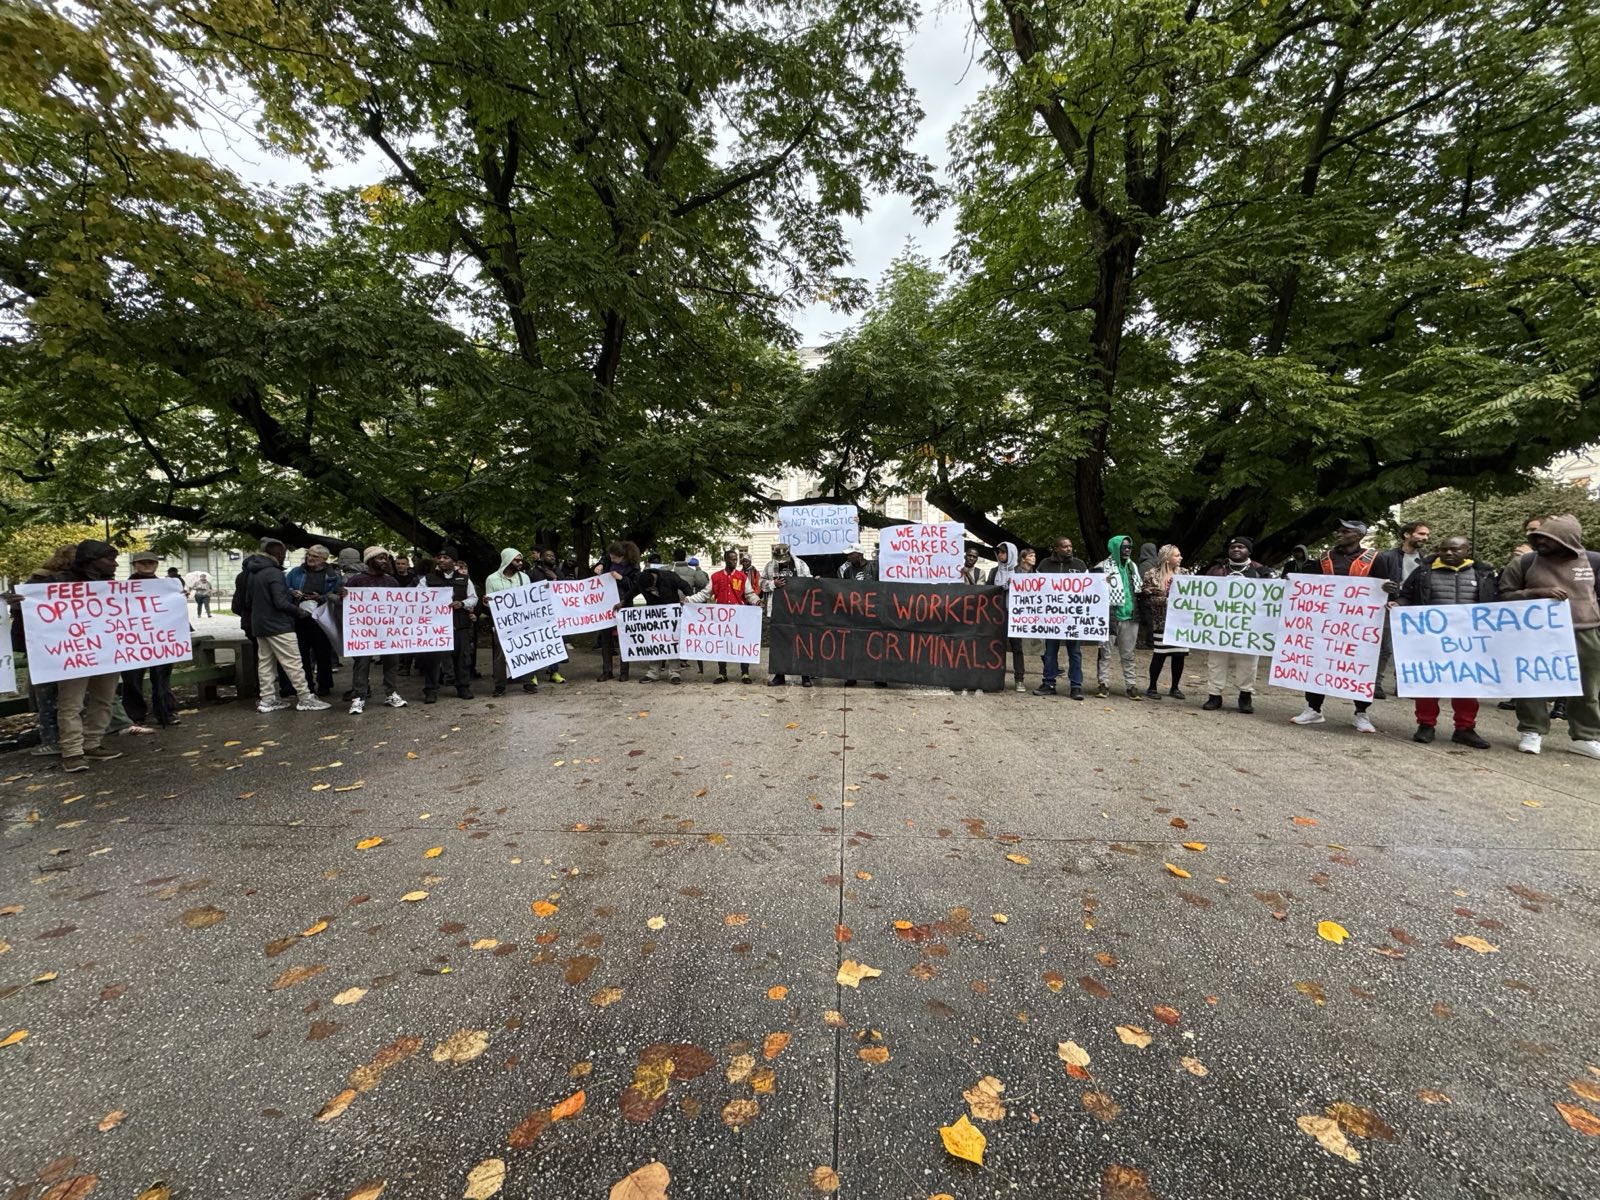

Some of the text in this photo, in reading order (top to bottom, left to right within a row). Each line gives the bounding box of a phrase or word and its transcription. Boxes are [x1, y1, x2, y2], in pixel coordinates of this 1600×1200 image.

[792, 506, 848, 517] RACISM
[811, 517, 854, 526] PATRIOTIC
[782, 529, 853, 547] ITS IDIOTIC
[895, 526, 947, 538] WE ARE
[890, 540, 960, 556] WORKERS
[909, 554, 933, 566] NOT
[886, 564, 963, 580] CRIMINALS
[47, 581, 143, 600] FEEL THE
[552, 578, 604, 594] VEDNO ZA
[1012, 577, 1093, 593] WOOP WOOP
[1176, 580, 1284, 601] WHO DO YO
[1291, 580, 1371, 599] SOME OF
[350, 590, 438, 603] IN A RACIST
[493, 584, 549, 611] POLICE
[561, 592, 605, 607] VSE KRIV
[783, 589, 877, 618] WE ARE
[1012, 593, 1101, 605] THAT'S THE SOUND
[37, 596, 168, 623] OPPOSITE
[349, 604, 453, 615] SOCIETY IT IS NOT
[496, 603, 555, 630] EVERYWHERE
[621, 609, 642, 622] THEY
[644, 608, 667, 620] HAVE
[697, 606, 737, 623] STOP
[892, 592, 1006, 625] WORKERS
[1012, 607, 1025, 615] OF
[1026, 606, 1043, 614] THE
[1173, 598, 1282, 617] CALL WHEN TH
[1289, 597, 1380, 619] THOSE THAT
[68, 616, 155, 637] OF SAFE
[349, 616, 433, 626] ENOUGH TO BE
[624, 619, 678, 633] AUTHORITY
[1012, 615, 1106, 626] WOOP WOOP THAT'S
[1193, 612, 1252, 632] POLICE
[1400, 603, 1565, 635] NO RACE
[351, 625, 449, 638] NON RACIST WE
[630, 633, 679, 644] TO KILL
[687, 622, 745, 639] RACIAL
[1010, 625, 1028, 633] THE
[1030, 625, 1060, 634] SOUND
[1083, 627, 1108, 636] BEAST
[1284, 616, 1381, 644] WOR FORCES
[44, 629, 176, 655] WHEN POLICE
[347, 637, 452, 651] MUST BE ANTI-RACIST
[505, 625, 561, 654] JUSTICE
[685, 639, 759, 657] PROFILING
[793, 629, 851, 660] NOT
[1175, 628, 1276, 652] MURDERS
[1284, 634, 1358, 657] ARE THE
[1441, 635, 1492, 653] BUT
[510, 642, 565, 669] NOWHERE
[627, 643, 679, 657] A MINORIT
[63, 653, 99, 671] ARE
[1280, 650, 1371, 676] SAME THAT
[1401, 654, 1580, 684] HUMAN RACE
[1274, 665, 1376, 698] BURN CROSSES
